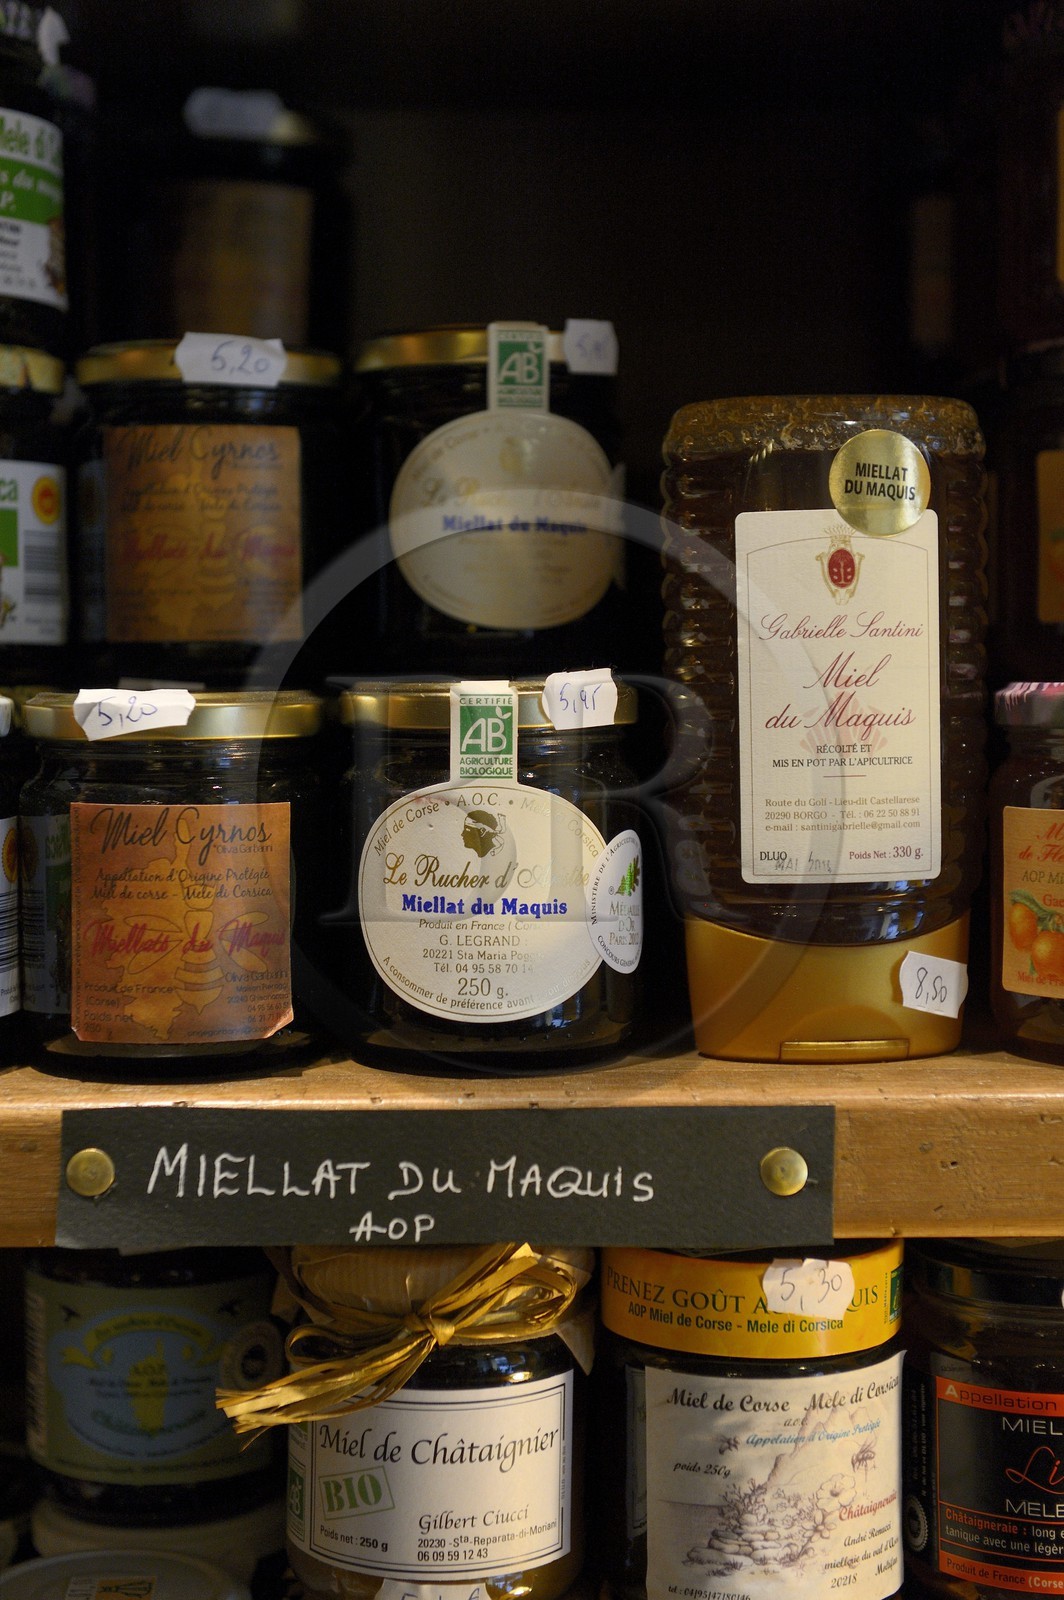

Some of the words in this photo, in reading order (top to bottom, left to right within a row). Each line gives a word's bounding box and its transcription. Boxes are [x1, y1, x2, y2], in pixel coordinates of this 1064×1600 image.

[210, 341, 271, 374] 5,20
[500, 352, 541, 384] AB
[855, 462, 908, 482] MIELLAT
[844, 479, 863, 495] DU
[866, 482, 916, 501] MAQUIS
[442, 515, 504, 532] Miellat
[509, 516, 530, 533] du
[759, 613, 847, 641] Gabrielle
[850, 610, 924, 638] Santini
[803, 651, 893, 688] Miel
[459, 697, 513, 705] CERTIFIÉ
[765, 703, 802, 729] du
[804, 690, 917, 741] Maquis
[460, 717, 507, 752] AB
[816, 743, 858, 754] RÉCOLTÉ
[860, 744, 873, 753] ET
[459, 757, 513, 766] AGRICULTURE
[459, 766, 513, 776] BIOLOGIQUE
[772, 759, 789, 768] MIS
[791, 759, 804, 768] EN
[807, 758, 827, 767] POT
[829, 758, 847, 767] PAR
[849, 756, 913, 766] L'APICULTRICE
[456, 792, 501, 807] A.O.C.
[765, 798, 792, 807] Route
[794, 798, 806, 807] du
[834, 797, 867, 806] Lieu-dit
[870, 796, 920, 805] Castellarese
[765, 811, 791, 820] 20290
[793, 811, 828, 820] BORGO
[840, 810, 856, 819] Tél.
[863, 810, 874, 818] 06
[876, 809, 886, 818] 22
[888, 809, 898, 817] 50
[899, 808, 910, 817] 88
[911, 808, 920, 816] 91
[90, 807, 170, 855] Miel
[176, 806, 273, 866] Cyrnos
[373, 828, 393, 856] Miel
[392, 819, 405, 834] de
[405, 802, 440, 823] Corse
[765, 823, 793, 832] e-mail
[800, 820, 921, 832] santinigabrielle@gmail.com
[759, 851, 788, 861] DLUO
[849, 851, 871, 860] Poids
[873, 850, 887, 859] Net
[893, 846, 912, 859] 330
[914, 848, 924, 859] g.
[1018, 846, 1033, 860] de
[383, 852, 408, 886] Le
[414, 853, 490, 888] Rucher
[1021, 869, 1046, 882] AOP
[91, 884, 116, 900] Miel
[119, 884, 133, 900] de
[136, 890, 169, 900] corse
[215, 884, 230, 898] di
[232, 884, 273, 898] Corsica
[401, 893, 465, 915] Miellat
[471, 897, 495, 915] du
[501, 897, 568, 919] Maquis
[419, 919, 452, 930] Produit
[455, 923, 468, 931] en
[470, 920, 505, 931] France
[439, 935, 452, 946] G.
[456, 935, 521, 947] LEGRAND
[422, 948, 453, 960] 20221
[457, 950, 474, 960] Sta
[477, 950, 507, 960] Maria
[434, 962, 453, 973] Tél.
[455, 963, 468, 973] 04
[472, 963, 485, 973] 95
[488, 964, 501, 973] 58
[505, 964, 518, 973] 70
[135, 984, 175, 994] France
[383, 956, 391, 966] A
[389, 965, 434, 999] consommer
[436, 993, 448, 1004] de
[450, 998, 503, 1010] préférence
[507, 996, 534, 1009] avant
[457, 977, 491, 996] 250
[496, 986, 509, 999] g.
[915, 966, 948, 1005] 8,50
[114, 1014, 134, 1022] net
[146, 1143, 371, 1199] MIELLAT
[487, 1155, 655, 1203] MAQUIS
[349, 1211, 436, 1243] AOP
[606, 1266, 665, 1305] PRENEZ
[672, 1289, 746, 1314] GOÛT
[780, 1267, 843, 1312] 5,30
[628, 1301, 647, 1318] AOP
[649, 1306, 673, 1325] Miel
[677, 1313, 692, 1328] de
[695, 1316, 733, 1332] Corse
[747, 1319, 779, 1334] Mele
[783, 1319, 795, 1334] di
[799, 1317, 844, 1334] Corsica
[666, 1387, 708, 1409] Miel
[712, 1394, 734, 1413] de
[739, 1394, 791, 1413] Corse
[803, 1391, 847, 1412] Mele
[849, 1386, 864, 1404] di
[866, 1374, 900, 1400] Corsica
[944, 1384, 1058, 1411] Appellation
[1001, 1416, 1064, 1436] MIEL
[319, 1424, 372, 1459] Miel
[373, 1431, 401, 1464] de
[411, 1426, 560, 1474] Châtaignier
[672, 1461, 702, 1474] poids
[703, 1462, 732, 1479] 250g
[322, 1473, 384, 1513] BIO
[1005, 1498, 1064, 1518] MELE
[418, 1510, 478, 1535] Gilbert
[482, 1503, 529, 1527] Ciucci
[945, 1507, 1019, 1535] Châtaigneraie
[1031, 1525, 1056, 1541] long
[320, 1524, 339, 1542] Poids
[340, 1531, 355, 1546] net
[359, 1536, 379, 1550] 250
[381, 1541, 389, 1553] g
[417, 1537, 447, 1549] 20230
[945, 1524, 980, 1545] tanique
[983, 1532, 1008, 1549] avec
[1010, 1539, 1031, 1552] une
[417, 1551, 430, 1562] 06
[432, 1551, 445, 1562] 09
[447, 1550, 460, 1561] 59
[463, 1550, 475, 1561] 12
[476, 1548, 489, 1560] 43
[830, 1572, 859, 1589] 20218
[946, 1557, 977, 1577] Produit
[978, 1566, 990, 1579] de
[993, 1569, 1026, 1586] France
